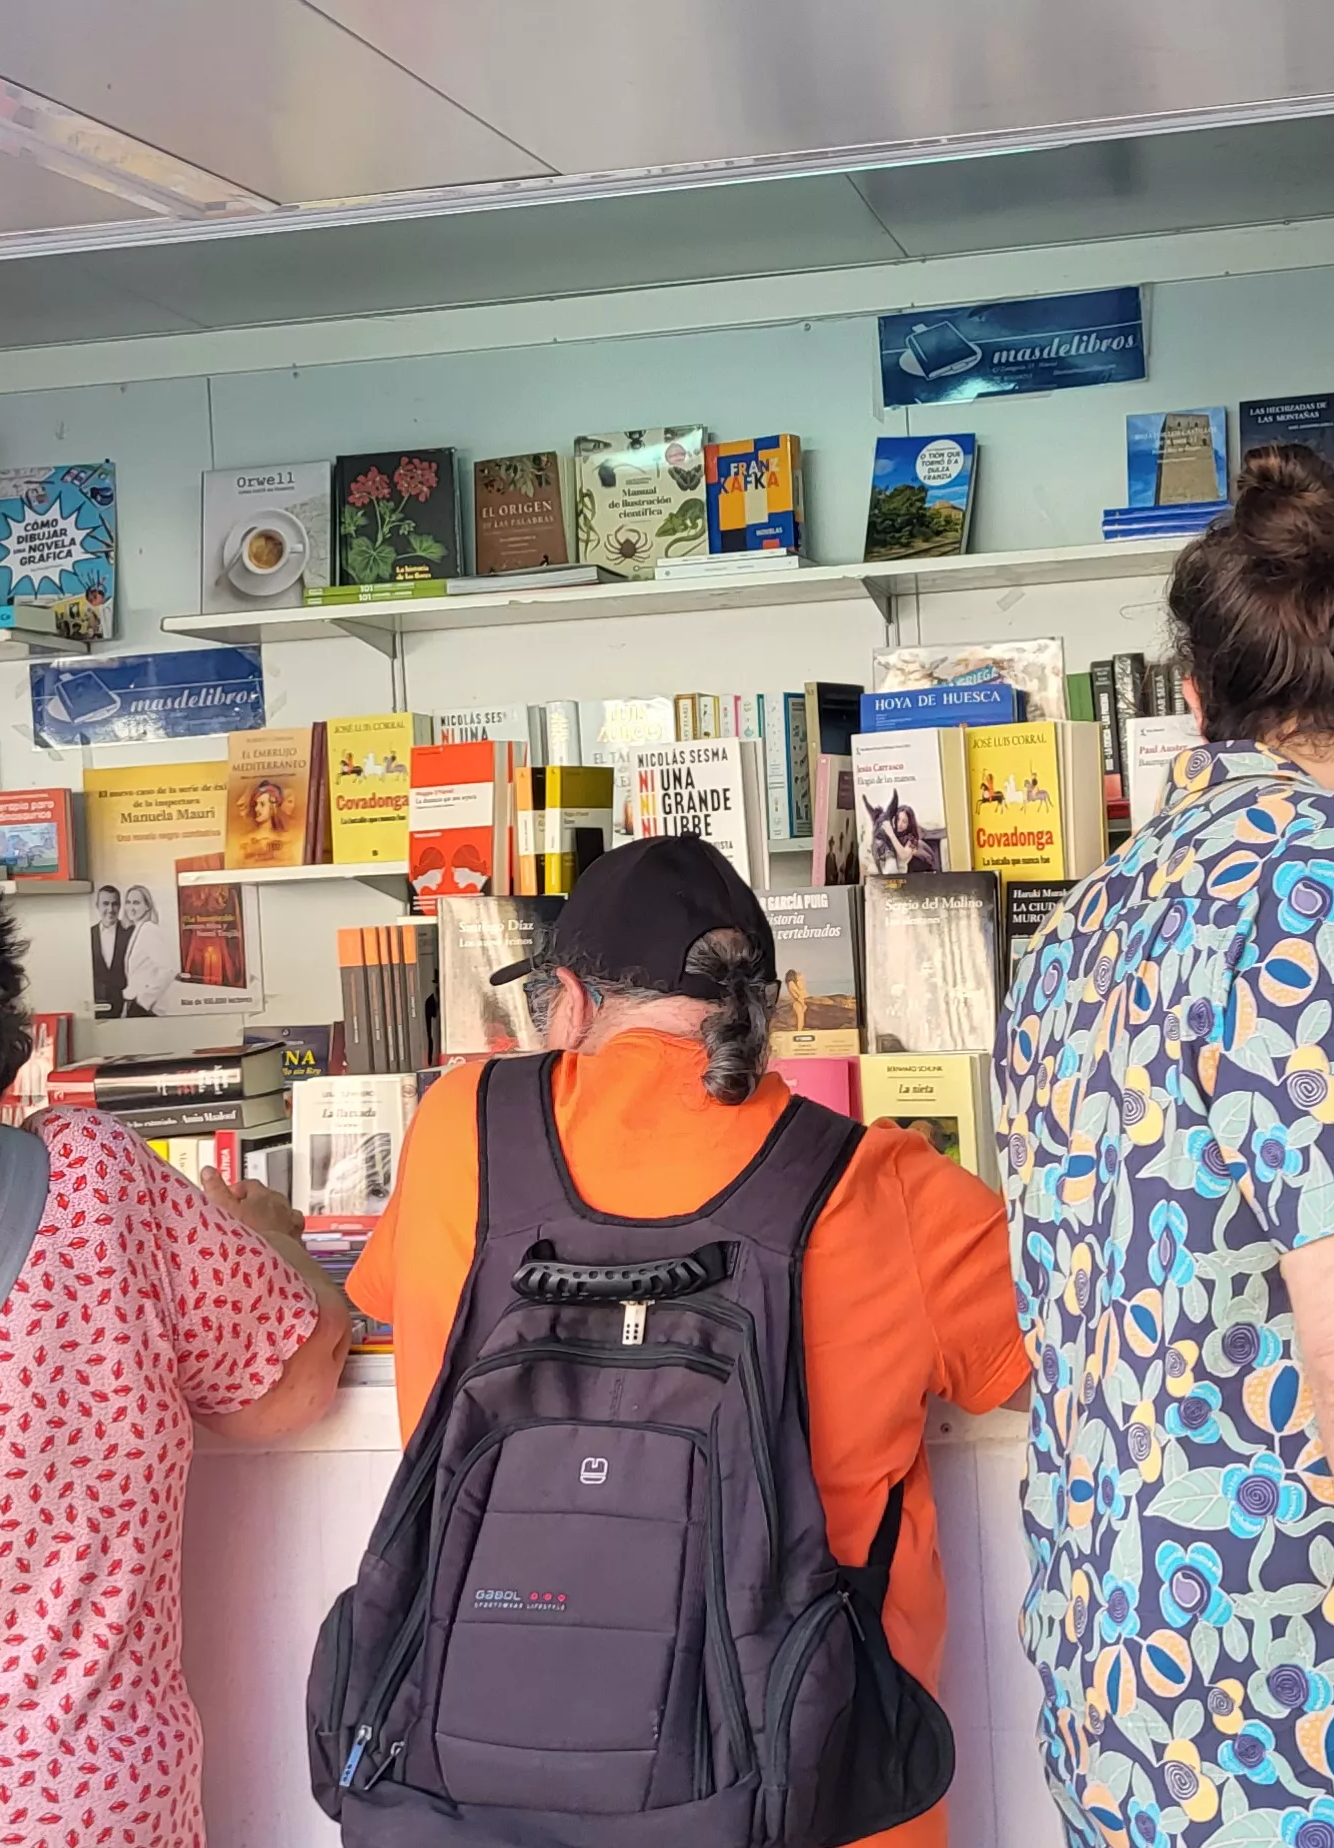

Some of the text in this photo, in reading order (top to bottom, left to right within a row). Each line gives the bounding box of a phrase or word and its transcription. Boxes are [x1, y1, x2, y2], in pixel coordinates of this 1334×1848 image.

[992, 332, 1135, 365] masdelibros
[730, 456, 779, 477] FRANZ
[237, 471, 295, 488] Orwell
[719, 471, 780, 495] KAFKA
[622, 486, 657, 497] Manual
[482, 500, 552, 518] EL ORIGEN
[23, 518, 59, 533] CÓMO
[16, 528, 68, 545] DIBUJAR
[28, 537, 77, 554] NOVELA
[874, 690, 1001, 711] HOYA DE HUESCA
[440, 711, 483, 727] NICOLÁS
[973, 732, 1047, 749] JOSÉ LUIS CORRAL
[636, 747, 729, 769] NICOLÁS SESMA
[1138, 745, 1158, 755] Paul
[637, 769, 656, 794] NI
[660, 766, 696, 792] UNA
[335, 792, 409, 811] Covadonga
[640, 787, 732, 817] NI GRANDE
[120, 806, 216, 824] Manuela Mauri
[641, 813, 713, 839] NI LIBRE
[976, 825, 1054, 852] Covadonga
[768, 892, 829, 911] GARCÍA PUIG
[1013, 888, 1041, 899] Haruki
[884, 896, 984, 914] Sergio del Molino
[1012, 902, 1027, 912] LA
[507, 919, 535, 931] Díaz
[898, 1082, 934, 1094] La nieta
[321, 1108, 334, 1119] La
